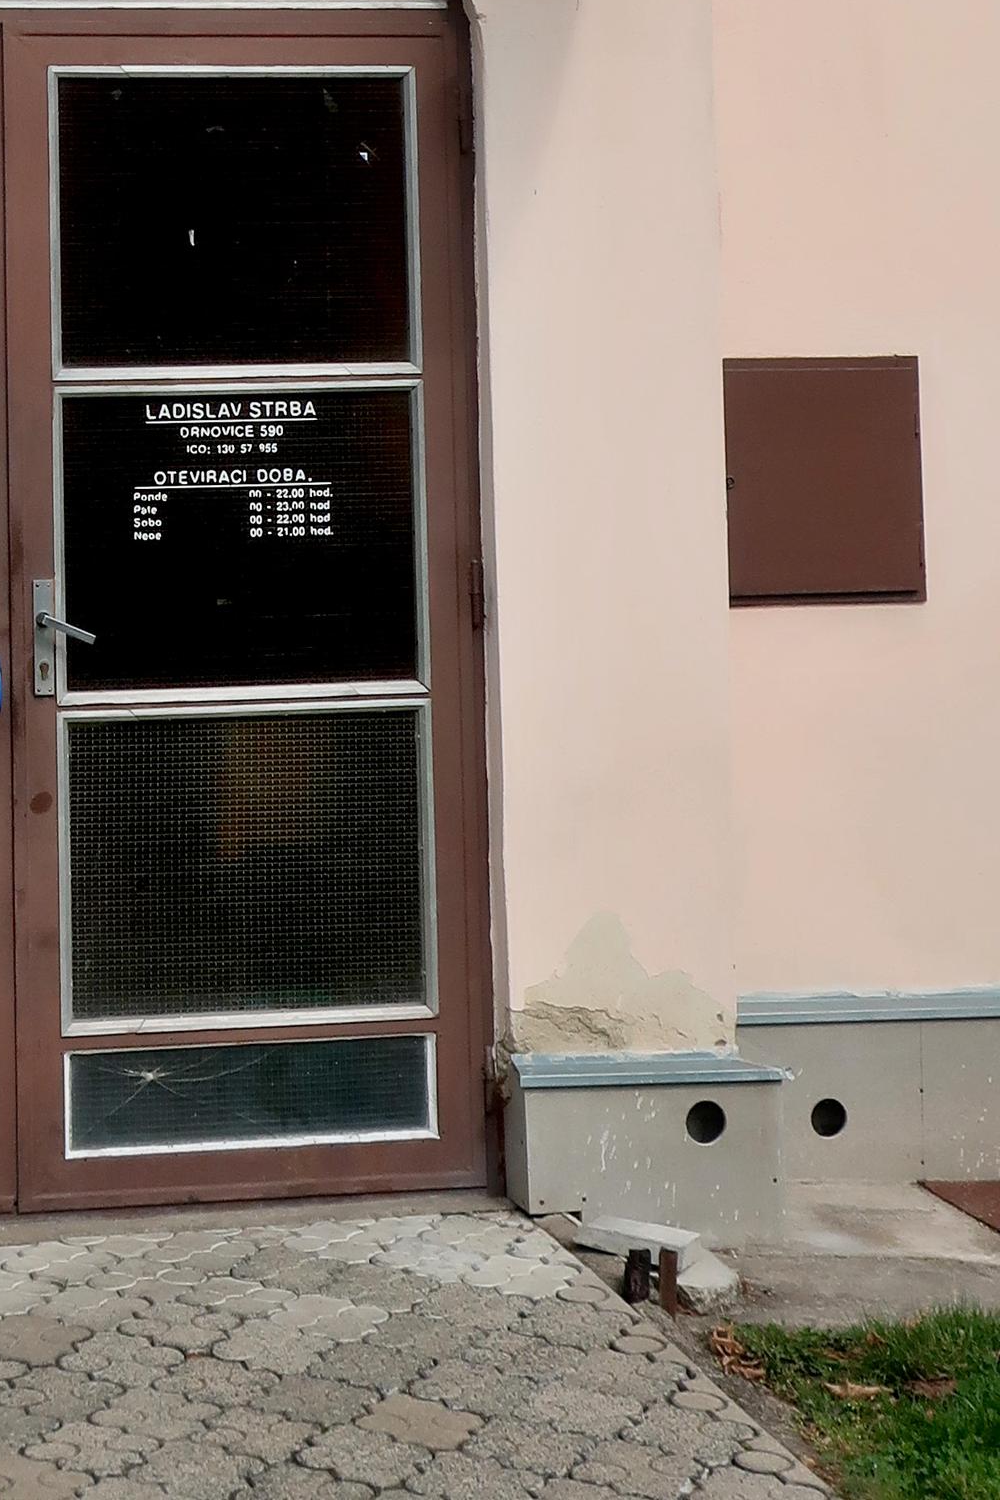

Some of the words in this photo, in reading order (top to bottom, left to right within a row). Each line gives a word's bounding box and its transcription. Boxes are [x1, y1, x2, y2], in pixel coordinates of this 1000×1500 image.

[145, 402, 242, 420] LADISLAV
[249, 400, 317, 418] STRBA
[180, 425, 254, 438] DRNOVICE
[260, 425, 284, 437] 590
[186, 444, 211, 455] ICO:
[217, 444, 234, 454] 130
[240, 443, 252, 454] 57
[154, 469, 247, 486] OTEVIRACI
[133, 492, 168, 502] Ponde
[276, 488, 304, 499] 22.00
[309, 487, 333, 498] hod.
[133, 518, 162, 528] Sobo
[249, 515, 263, 525] 00
[276, 514, 305, 525] 22.00
[250, 528, 263, 538] 00
[277, 526, 305, 538] 21.00
[310, 526, 334, 537] hod.
